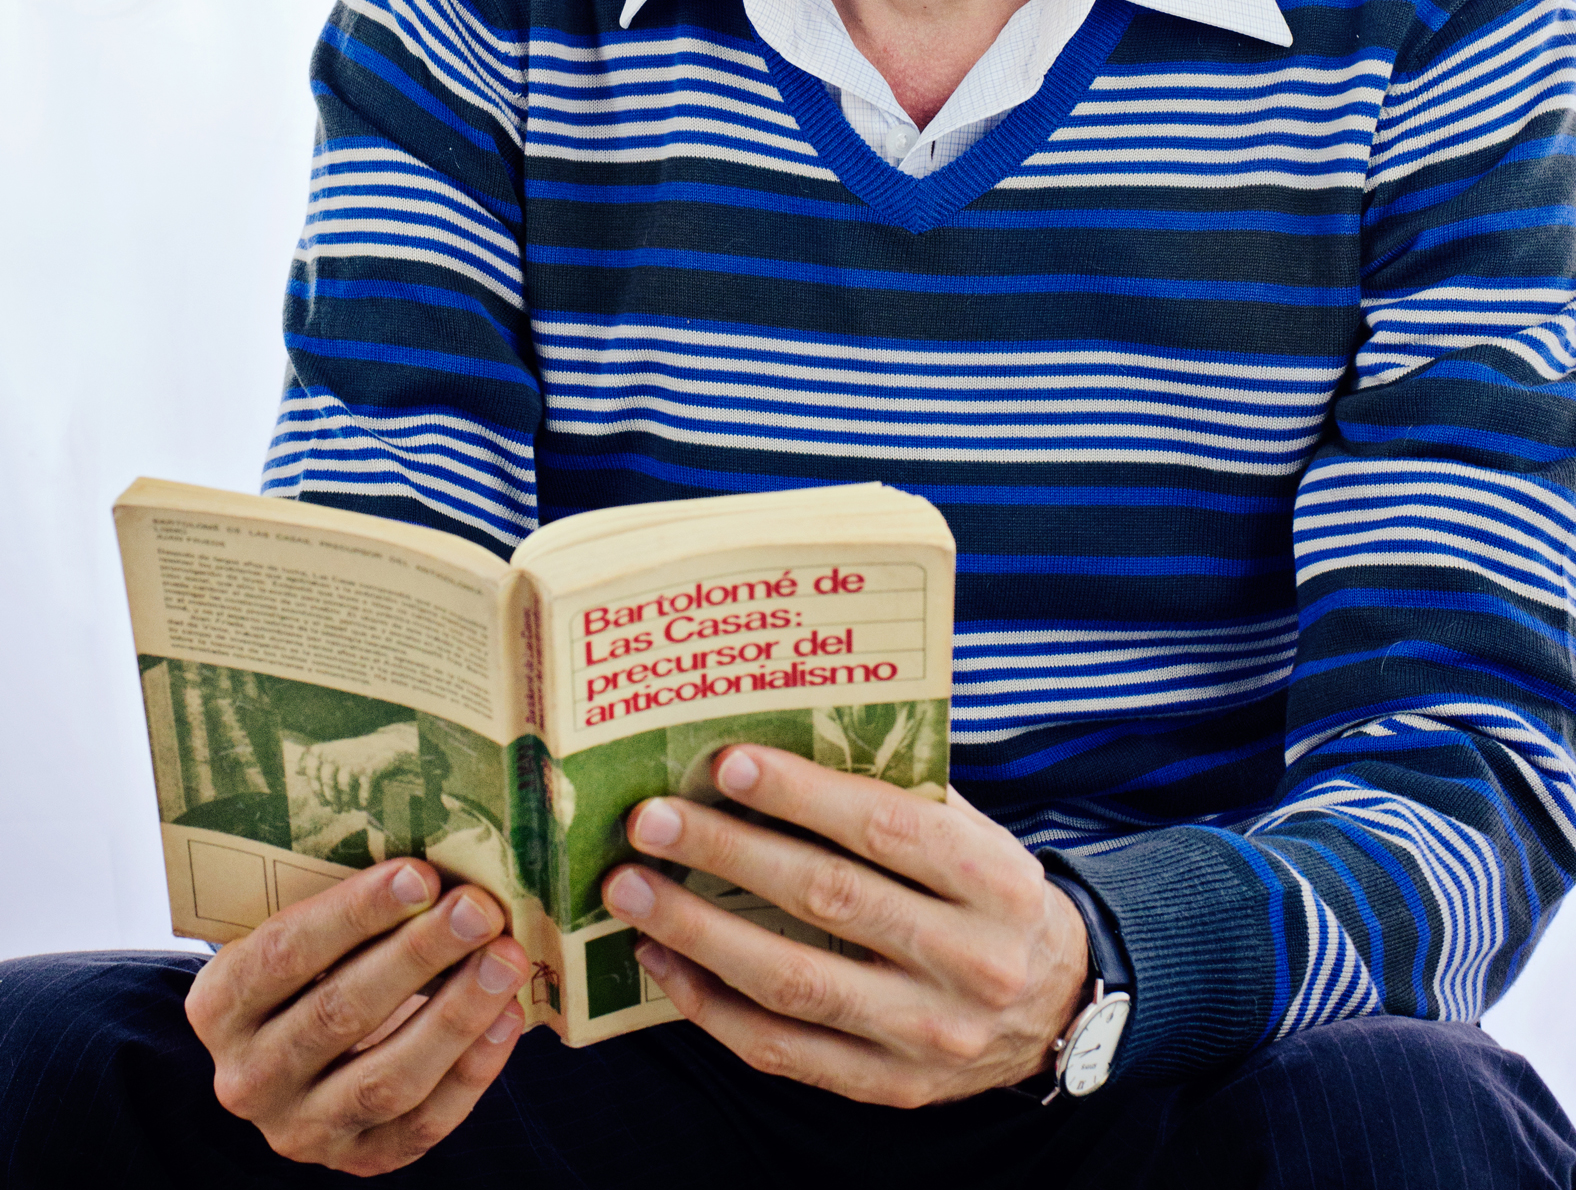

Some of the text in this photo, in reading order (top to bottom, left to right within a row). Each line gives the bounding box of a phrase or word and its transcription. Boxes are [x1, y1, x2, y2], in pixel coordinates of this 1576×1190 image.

[583, 567, 865, 637] Bartolomé de
[585, 608, 803, 666] Las Casas:
[587, 628, 853, 701] precursor del
[585, 661, 898, 727] anticolonialismo
